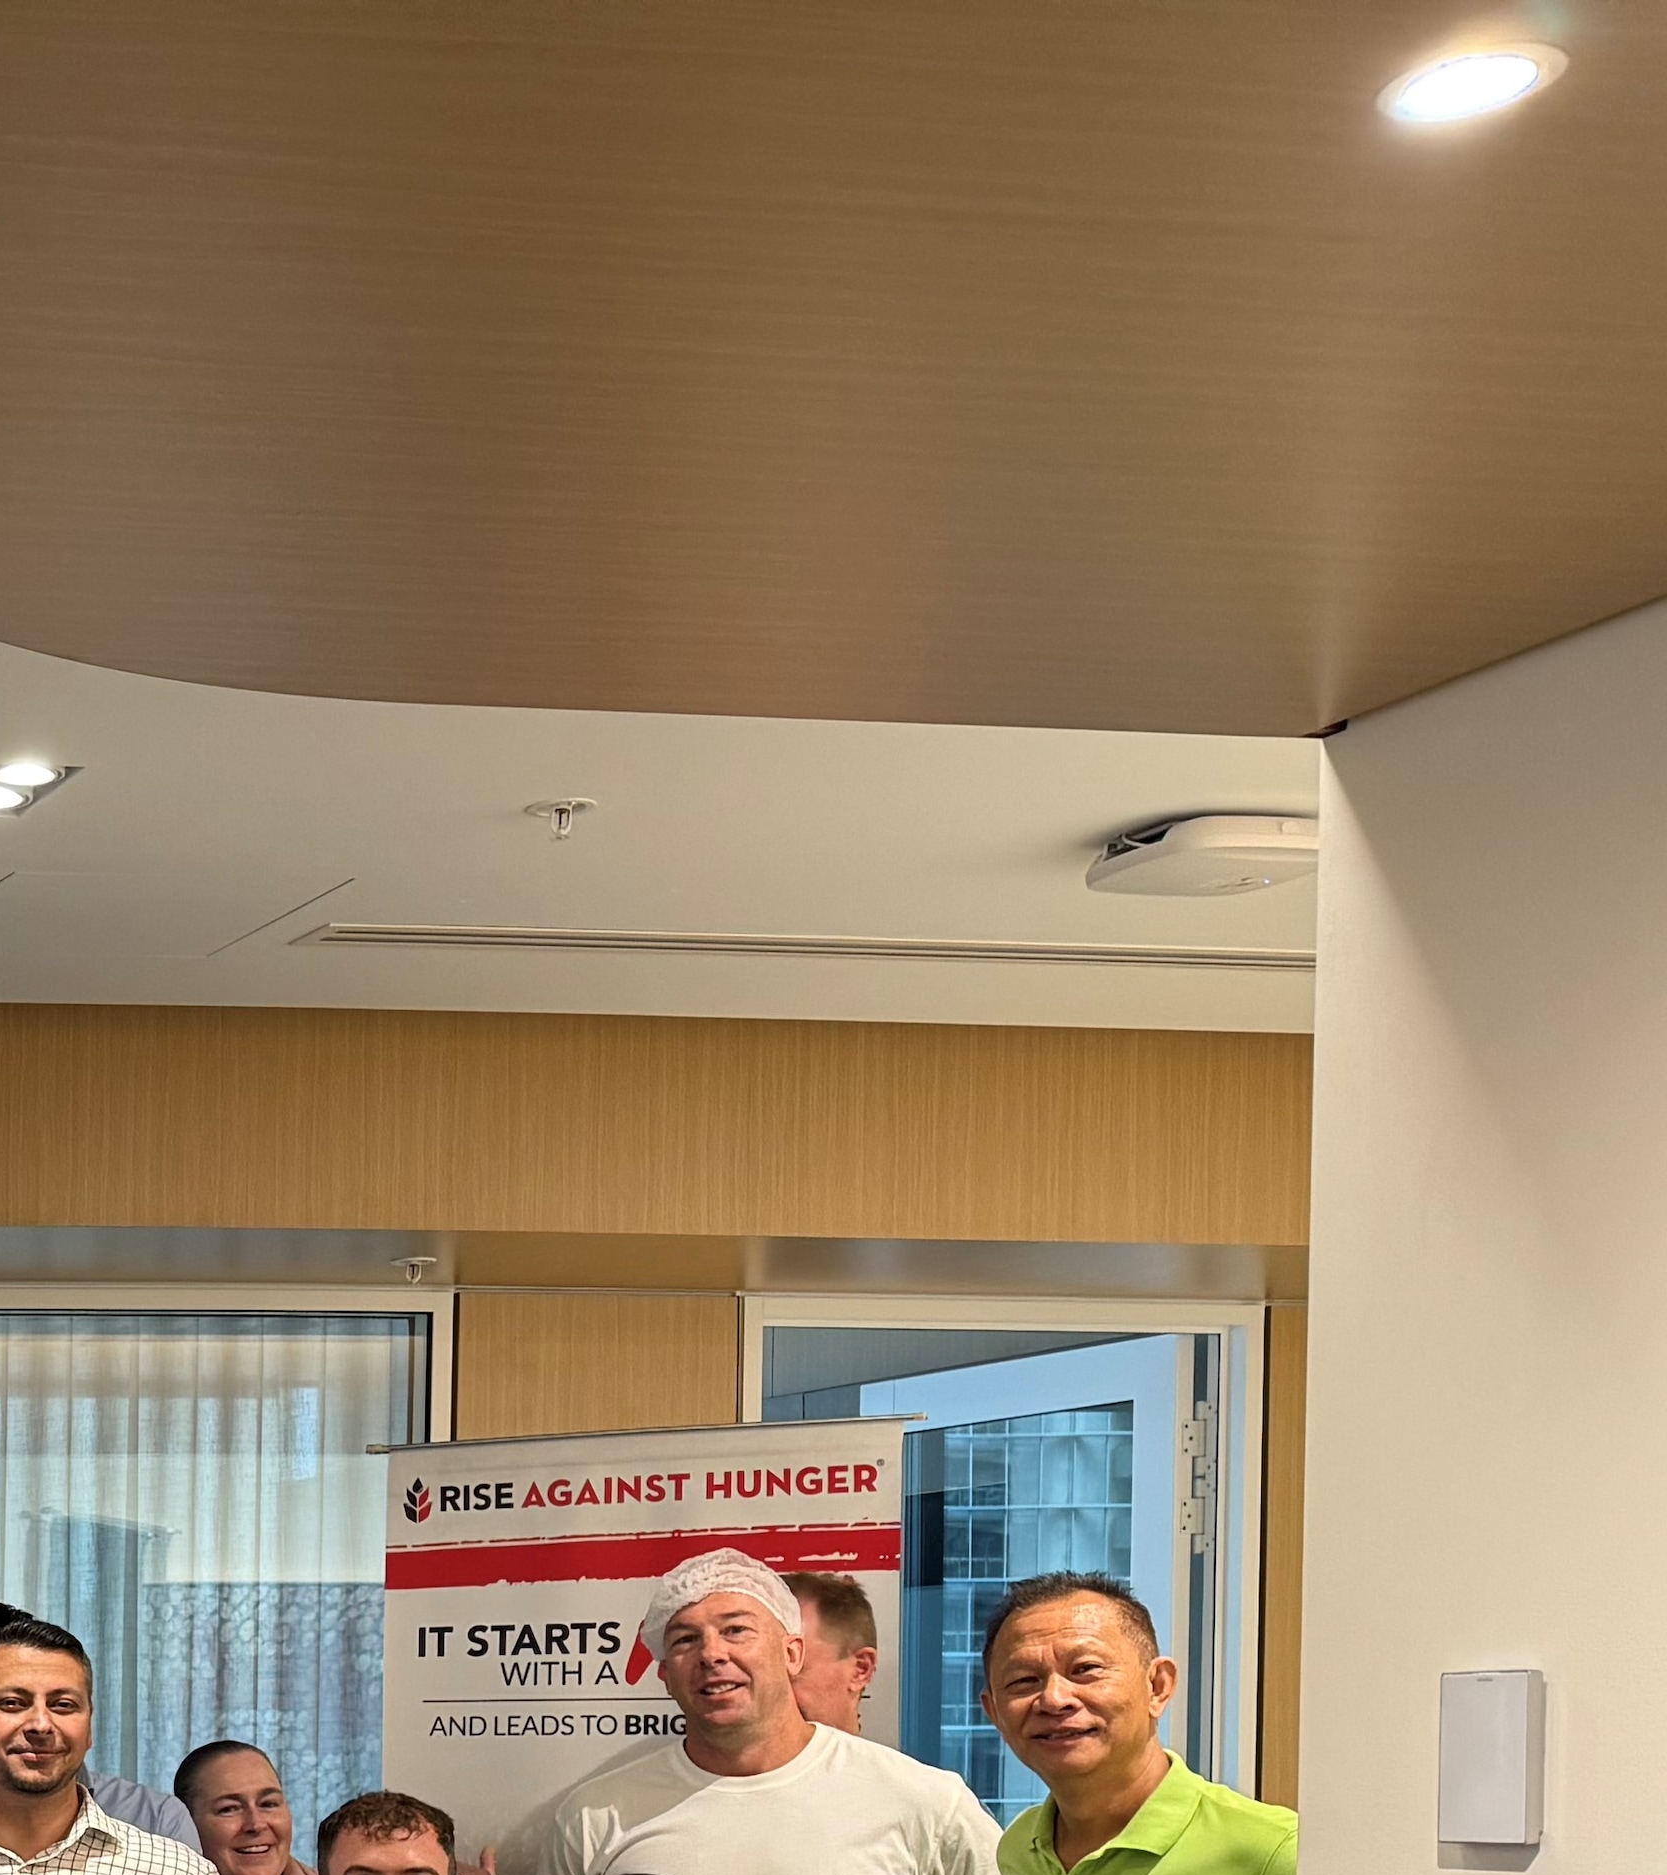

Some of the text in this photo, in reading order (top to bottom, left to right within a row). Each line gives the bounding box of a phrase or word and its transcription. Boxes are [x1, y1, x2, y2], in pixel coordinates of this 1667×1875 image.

[439, 1482, 514, 1512] RISE
[521, 1473, 691, 1509] AGAINST
[705, 1464, 877, 1499] HUNGER
[418, 1626, 453, 1658] IT
[467, 1621, 621, 1657] STARTS
[500, 1660, 619, 1686] WITH A
[429, 1714, 687, 1736] AND LEADS TO BRIG
